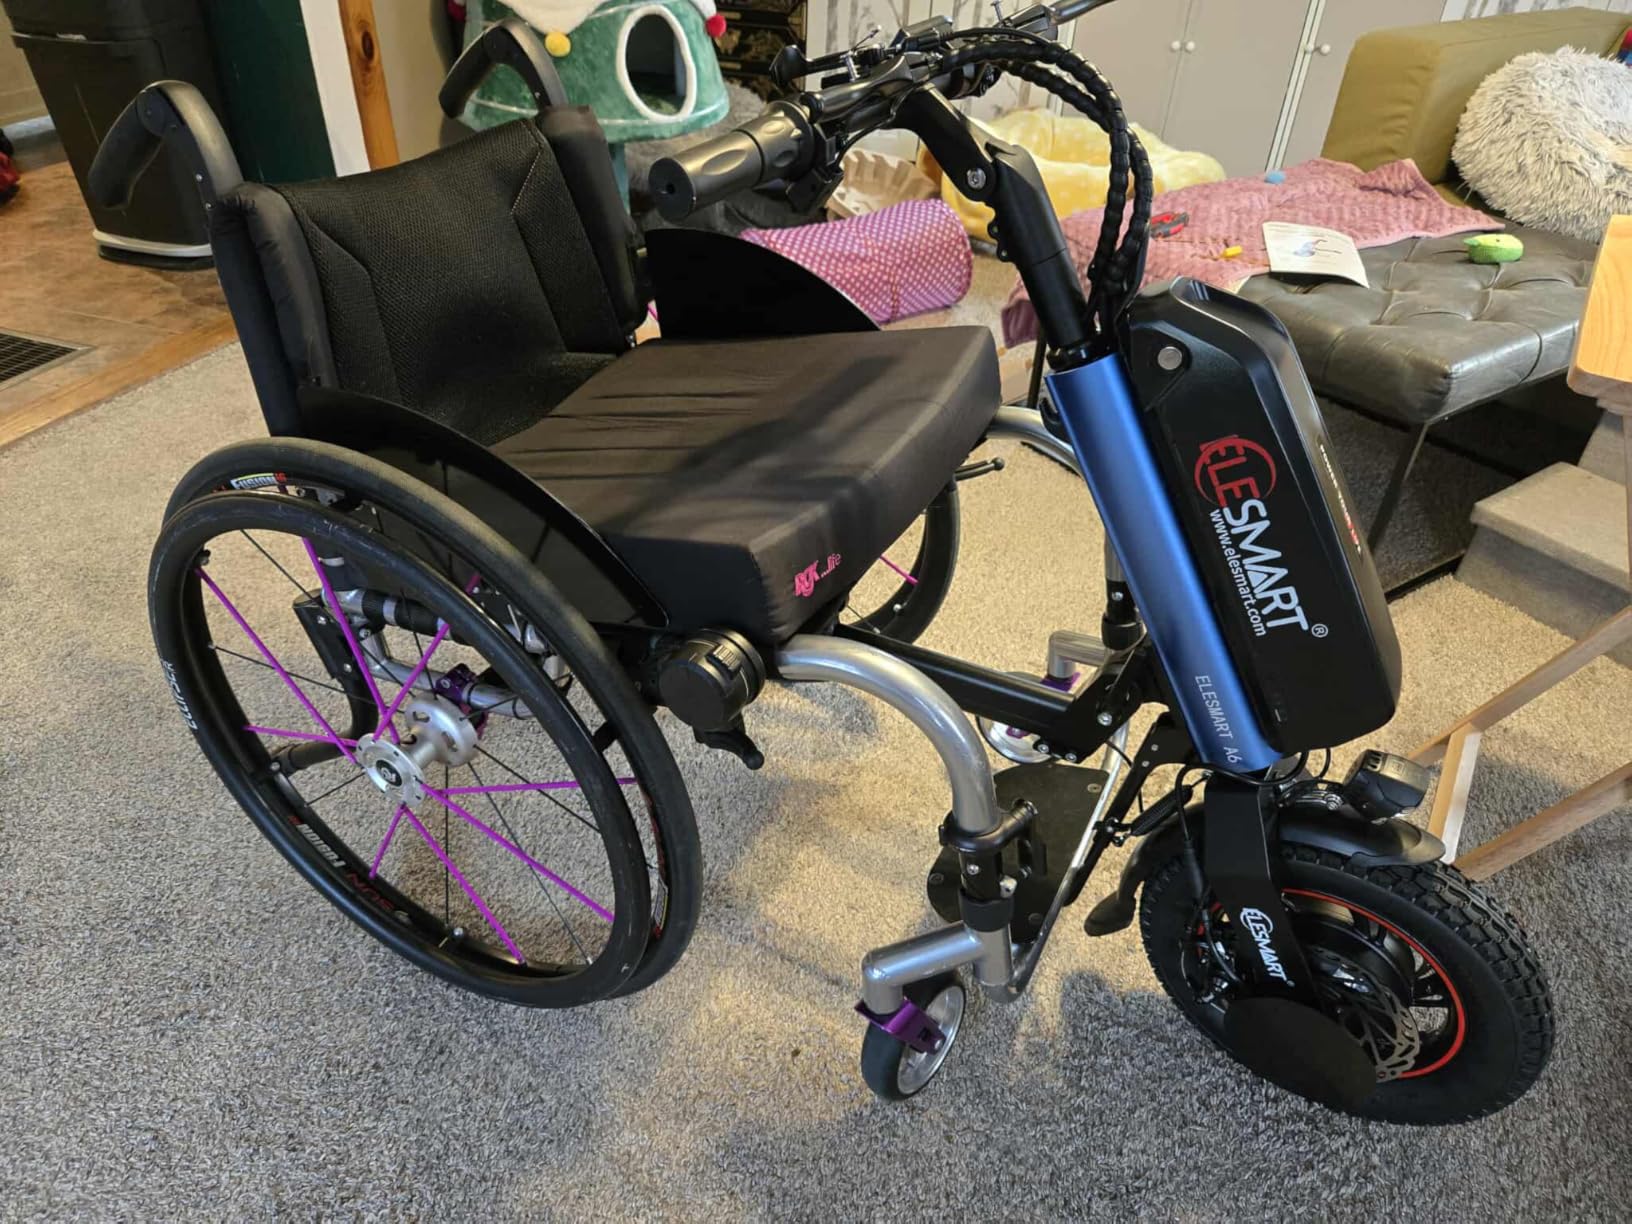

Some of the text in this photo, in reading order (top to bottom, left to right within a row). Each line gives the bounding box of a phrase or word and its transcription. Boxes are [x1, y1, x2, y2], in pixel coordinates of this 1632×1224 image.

[1195, 435, 1309, 631] ELESMART
[1210, 508, 1267, 637] www.elesmart.com
[1195, 675, 1243, 764] ELESMART A6
[1240, 907, 1287, 981] ELESMART
